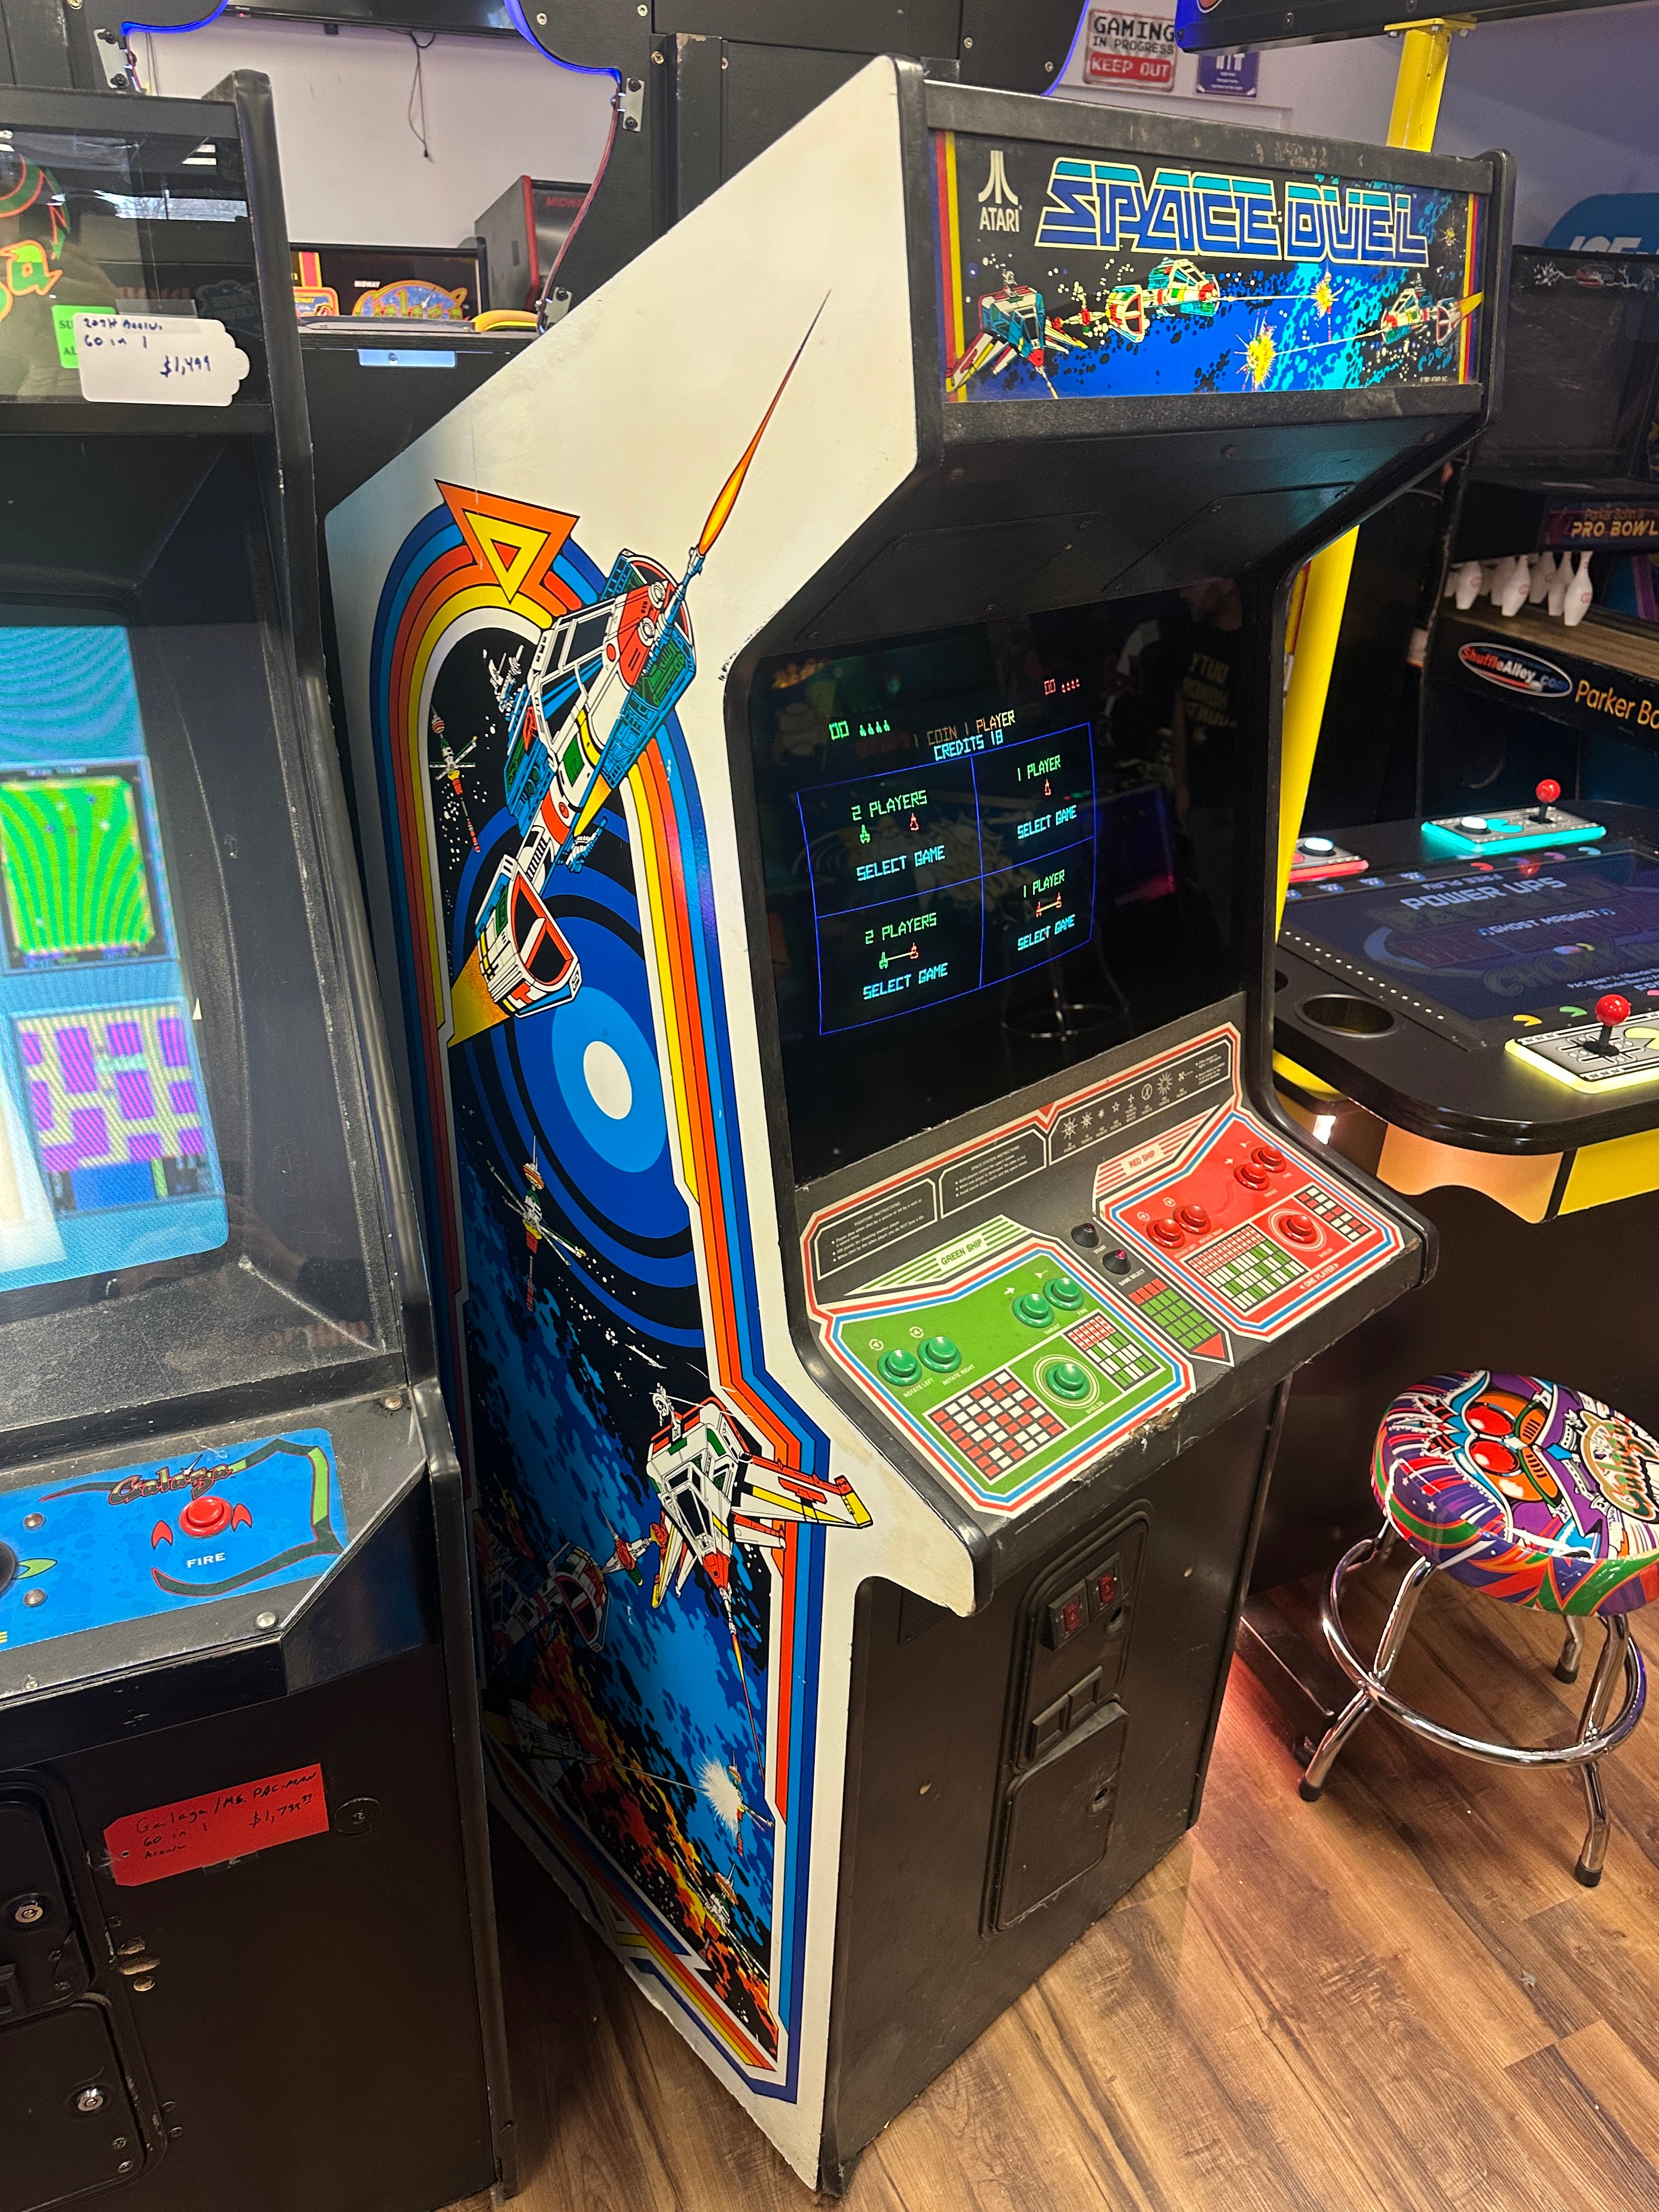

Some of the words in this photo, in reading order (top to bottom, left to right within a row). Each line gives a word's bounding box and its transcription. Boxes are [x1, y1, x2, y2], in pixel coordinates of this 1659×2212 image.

[1093, 16, 1174, 42] GAMING
[1092, 36, 1107, 48] IN
[1114, 38, 1174, 54] PROGRESS
[1091, 57, 1133, 73] KEEP
[1139, 62, 1169, 77] OUT
[979, 205, 1020, 232] ATARI
[1035, 157, 1282, 261] SPACE
[1284, 181, 1429, 268] DUEL
[84, 335, 103, 347] 60
[1571, 521, 1605, 538] PRO
[1575, 679, 1636, 720] Parker
[927, 727, 957, 746] COIN
[976, 709, 1015, 732] PLAYER
[934, 734, 985, 761] CREDITS
[991, 729, 1003, 745] 18
[1027, 754, 1061, 779] PLAYER
[851, 805, 862, 821] 2
[869, 790, 927, 818] PLAYERS
[1017, 815, 1052, 839] SELECT
[1056, 805, 1077, 826] GAME
[856, 855, 907, 881] SELECT
[915, 845, 945, 867] GAME
[1032, 870, 1065, 895] PLAYER
[1400, 885, 1508, 910] POWER
[1502, 876, 1568, 894] UPS
[865, 930, 873, 945] 2
[882, 912, 936, 941] PLAYERS
[1017, 926, 1052, 951] SELECT
[1054, 914, 1075, 935] GAME
[1488, 919, 1539, 935] GHOST
[1540, 909, 1601, 925] MAGNET
[863, 974, 911, 1000] SELECT
[918, 962, 948, 984] GAME
[1128, 1157, 1141, 1168] RED
[1142, 1150, 1155, 1161] SHIP
[941, 1248, 966, 1265] GREEN
[966, 1239, 982, 1252] SHIP
[1093, 1245, 1107, 1254] START
[1118, 1277, 1131, 1286] GAME
[1130, 1268, 1146, 1280] SELECT
[1304, 1276, 1317, 1287] ONE
[1316, 1264, 1336, 1279] PLAYER
[1043, 1323, 1061, 1335] THRUST
[942, 1372, 961, 1386] ROTATE
[958, 1364, 975, 1378] RIGHT
[904, 1385, 923, 1398] ROTATE
[922, 1378, 935, 1390] LEFT
[109, 1466, 234, 1505] Galaga
[187, 1553, 226, 1568] FIRE
[144, 1835, 162, 1847] 60
